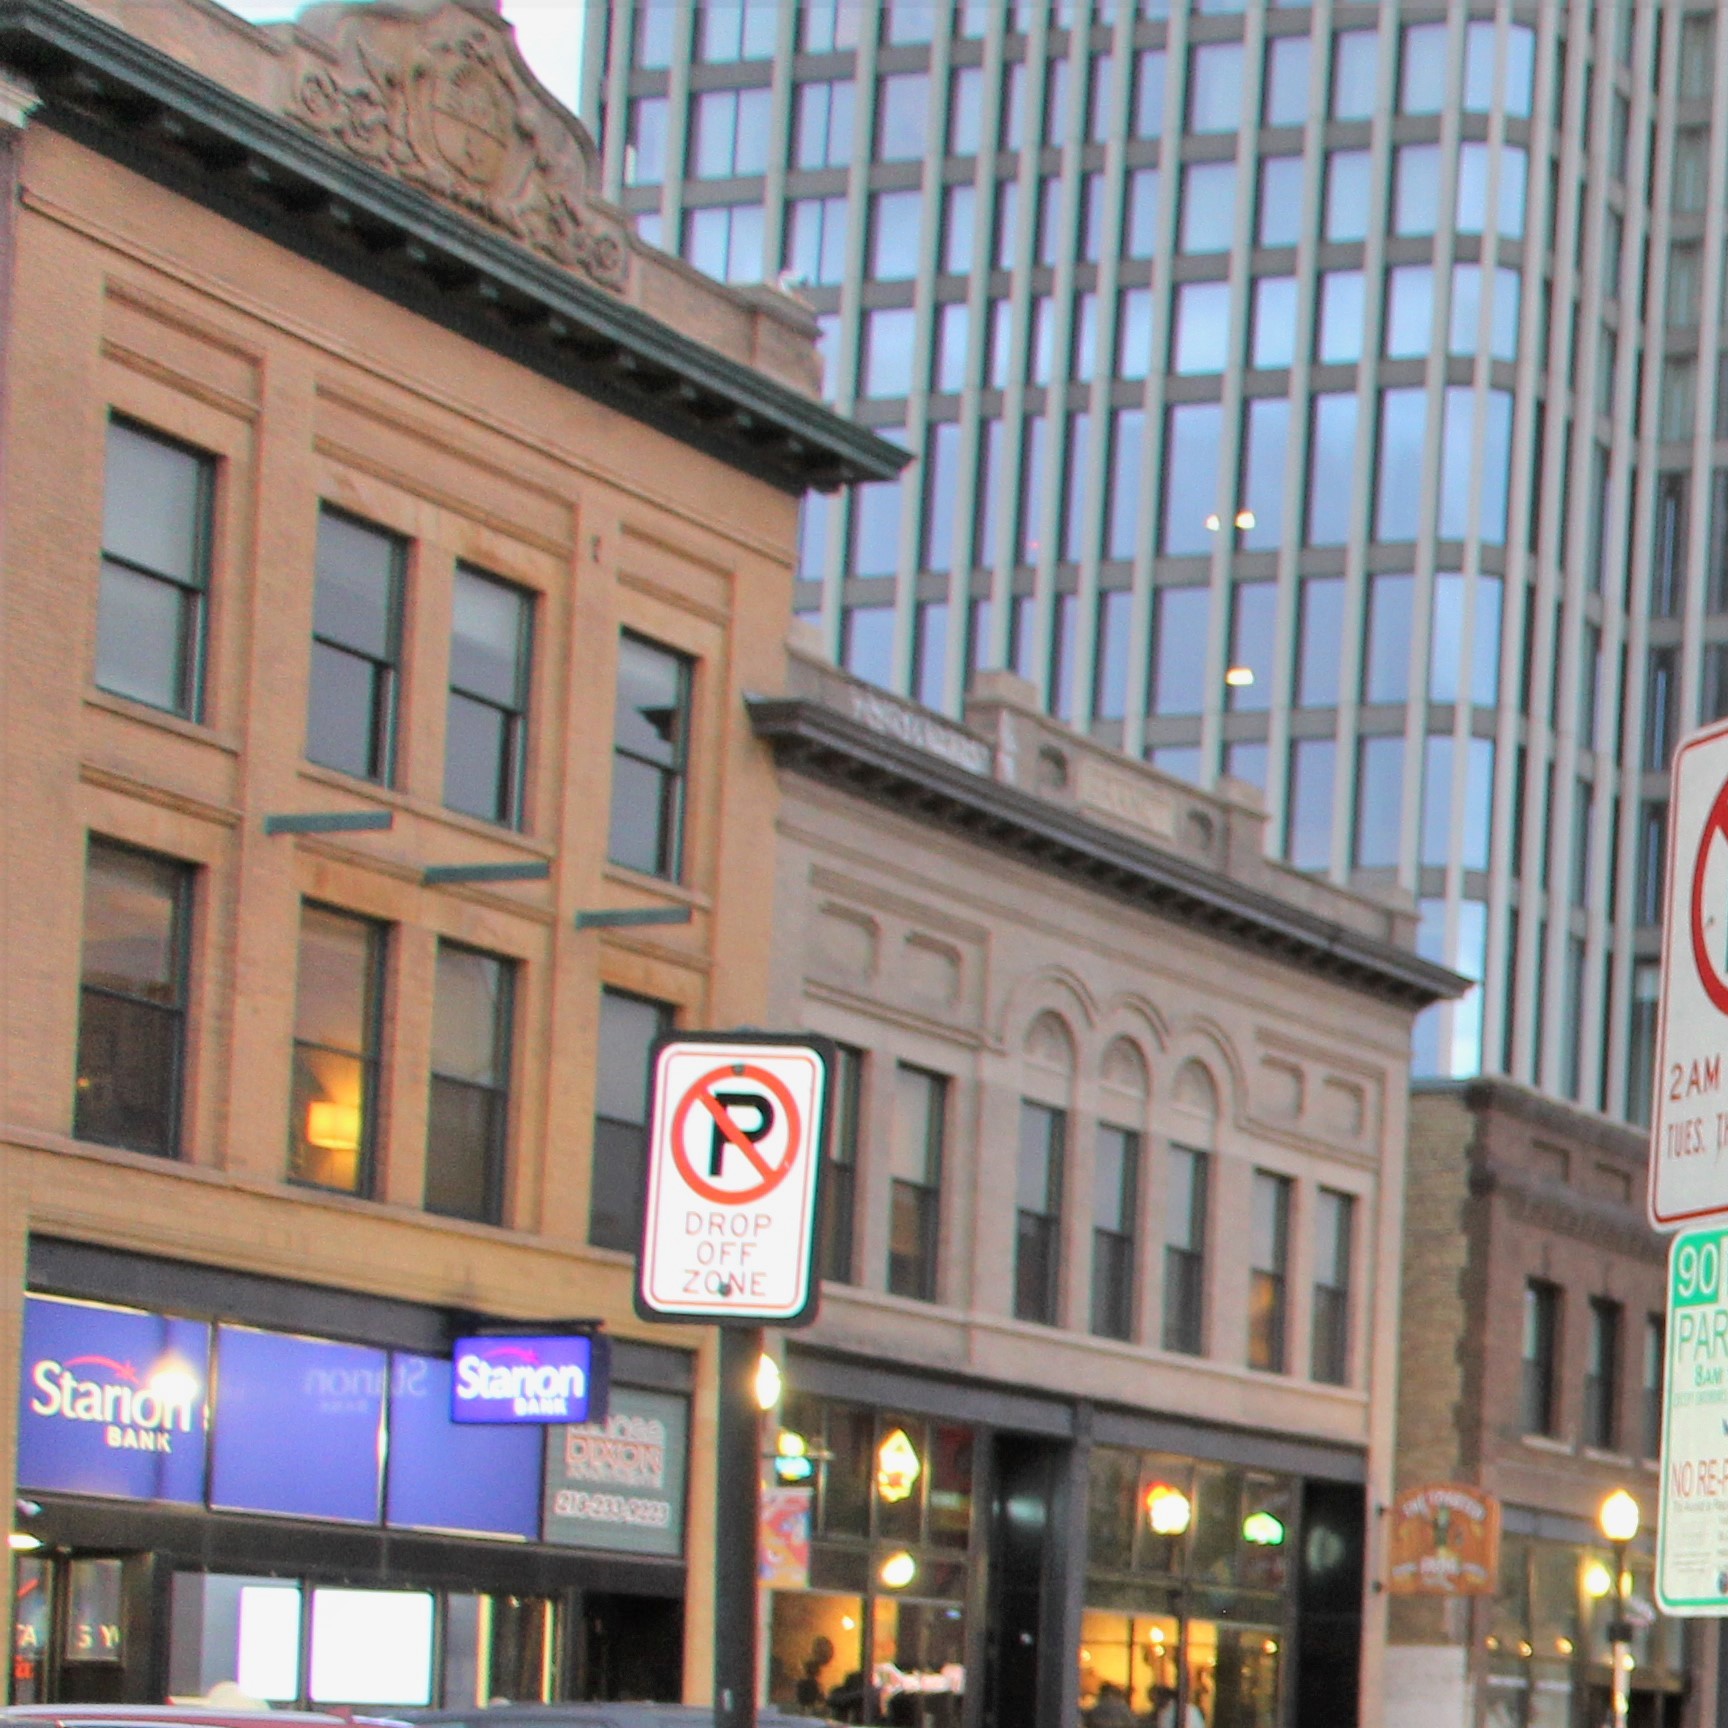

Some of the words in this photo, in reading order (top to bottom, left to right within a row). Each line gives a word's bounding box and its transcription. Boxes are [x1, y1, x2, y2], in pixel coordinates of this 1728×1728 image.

[1669, 1053, 1722, 1101] 2AM
[685, 1210, 772, 1238] DROP
[696, 1240, 757, 1266] OFF
[682, 1269, 768, 1297] ZONE
[1678, 1243, 1718, 1298] 90
[513, 1397, 568, 1417] BANK
[105, 1425, 172, 1453] BANK
[1671, 1460, 1692, 1498] NO
